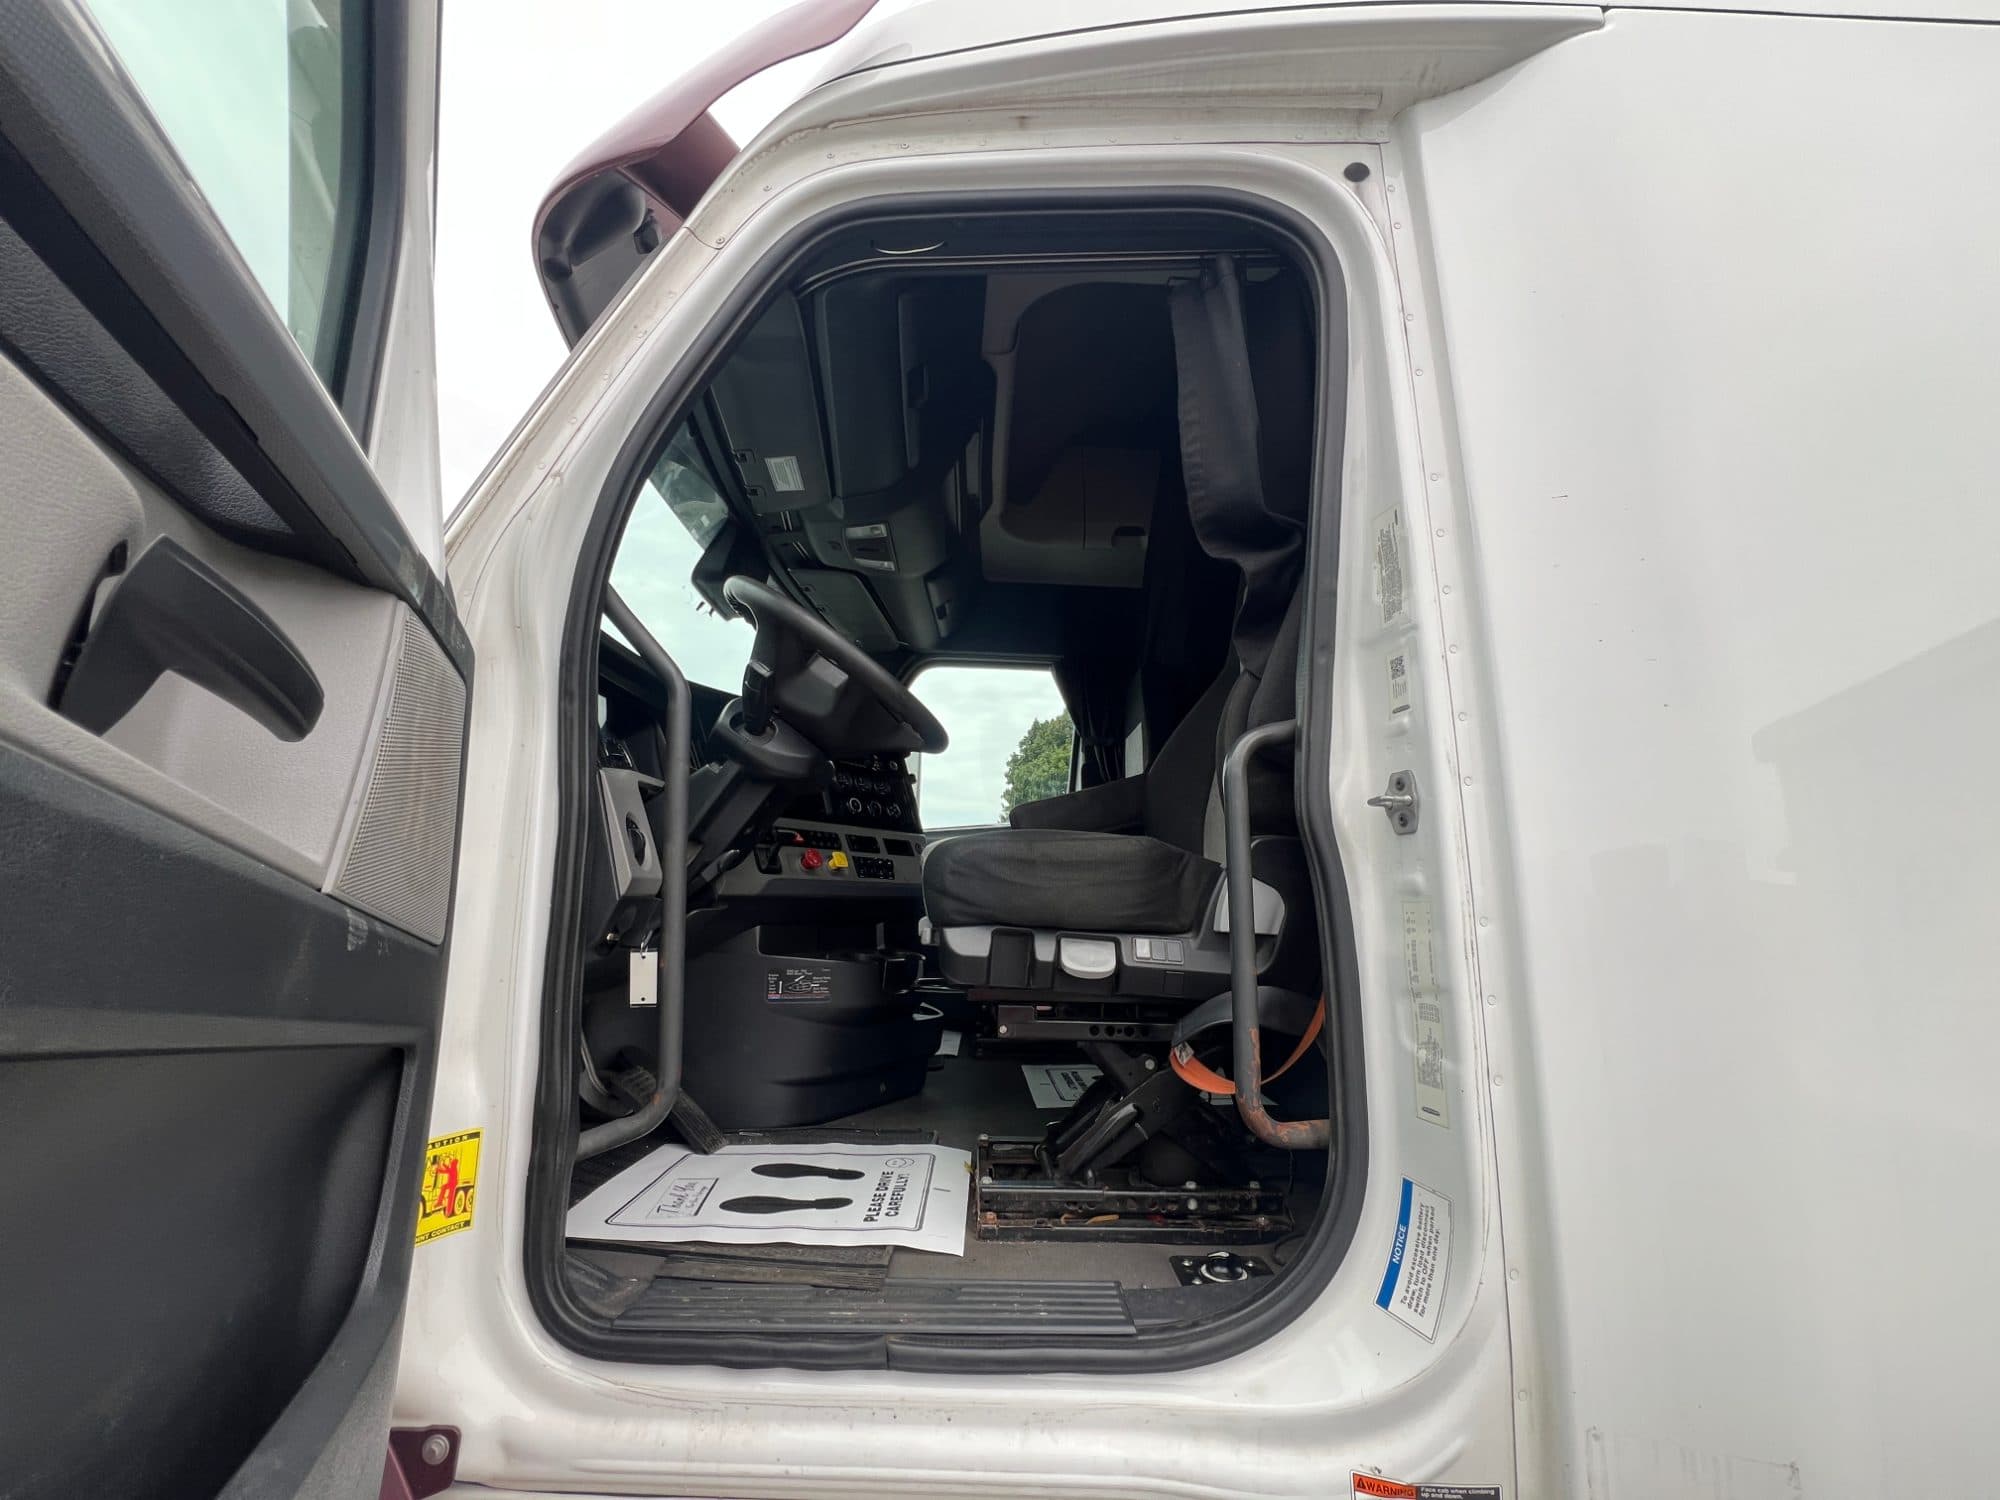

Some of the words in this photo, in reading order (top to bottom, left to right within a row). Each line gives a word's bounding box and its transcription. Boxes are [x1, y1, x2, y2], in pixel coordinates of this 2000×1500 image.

[426, 1135, 468, 1150] AUTION
[863, 1192, 887, 1222] PLEASE
[875, 1170, 894, 1191] DRIVE
[430, 1221, 465, 1238] CONTACT
[1392, 1224, 1407, 1264] NOTICE
[1413, 1270, 1421, 1287] turn
[1417, 1250, 1425, 1269] load
[1421, 1205, 1429, 1248] disconnect
[1400, 1295, 1408, 1304] To
[1405, 1271, 1414, 1295] avoid
[1411, 1232, 1422, 1270] excessive
[1422, 1257, 1430, 1275] OFF
[1418, 1304, 1426, 1317] for
[1428, 1264, 1436, 1281] than
[1420, 1277, 1427, 1286] to
[1413, 1287, 1424, 1313] switch
[1366, 1482, 1415, 1497] WARNING
